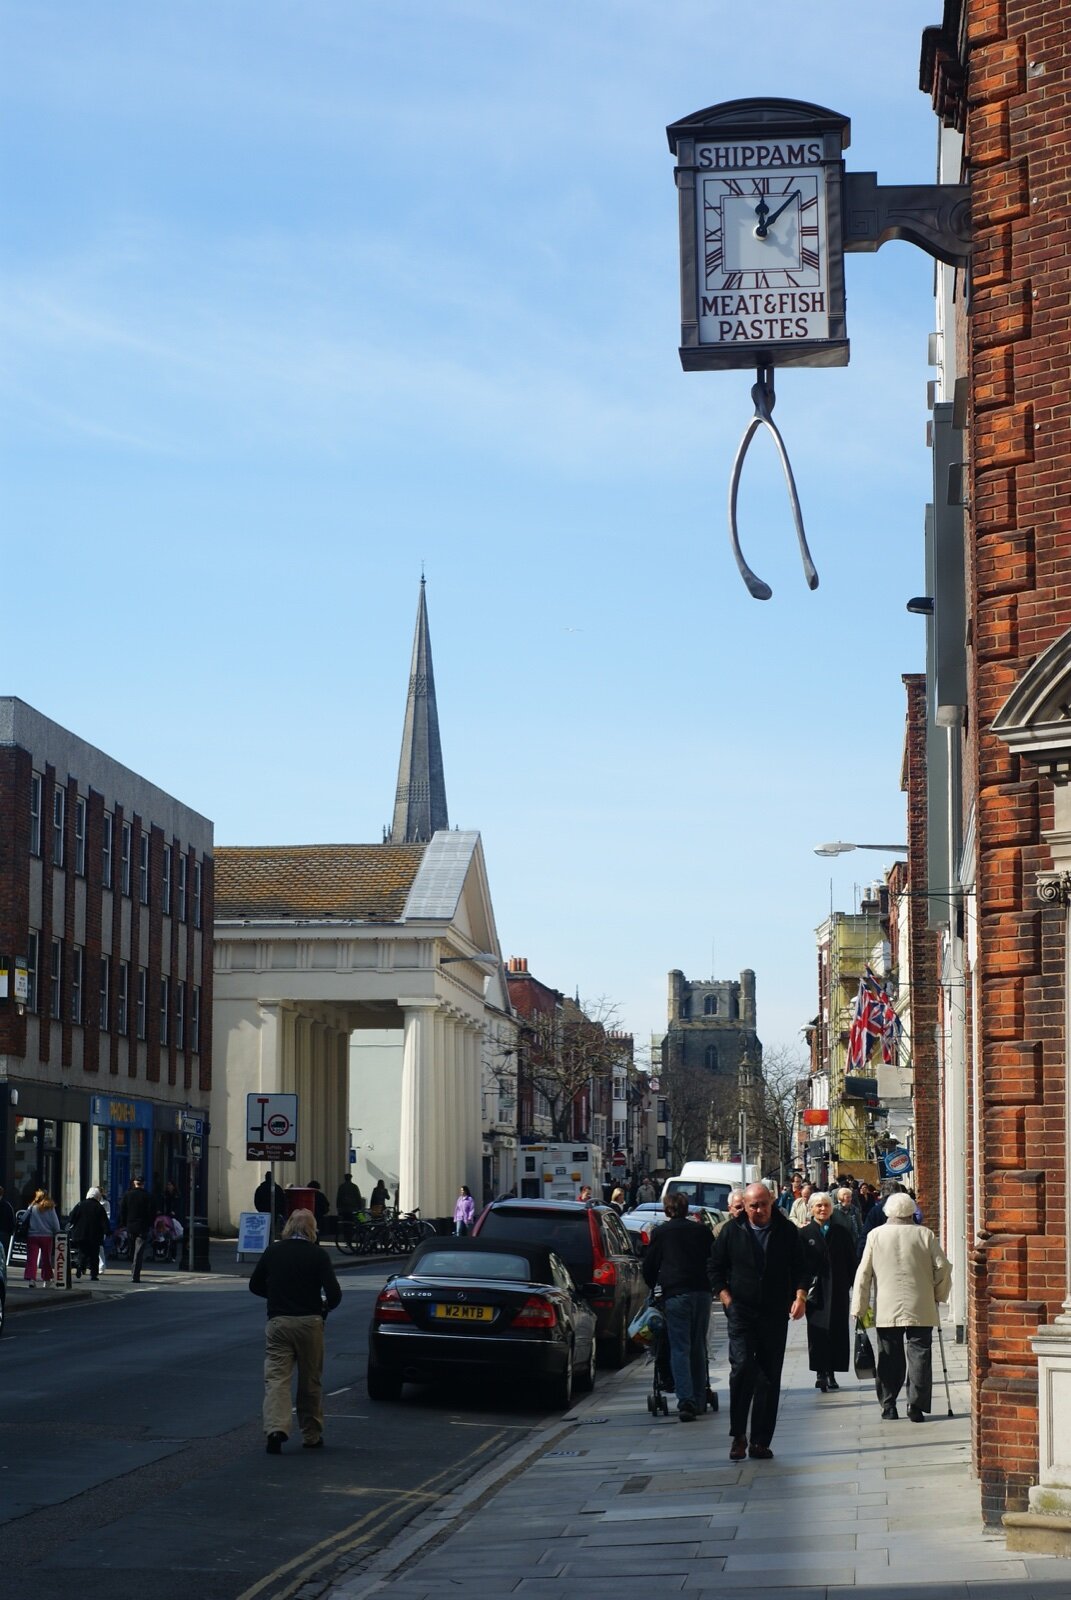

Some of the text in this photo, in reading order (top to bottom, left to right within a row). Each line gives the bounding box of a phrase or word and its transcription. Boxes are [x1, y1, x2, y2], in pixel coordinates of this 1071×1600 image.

[699, 143, 822, 169] SHIPPAMS
[718, 317, 809, 342] PASTES
[56, 1243, 65, 1281] CAFE
[445, 1304, 484, 1318] W2 MTB
